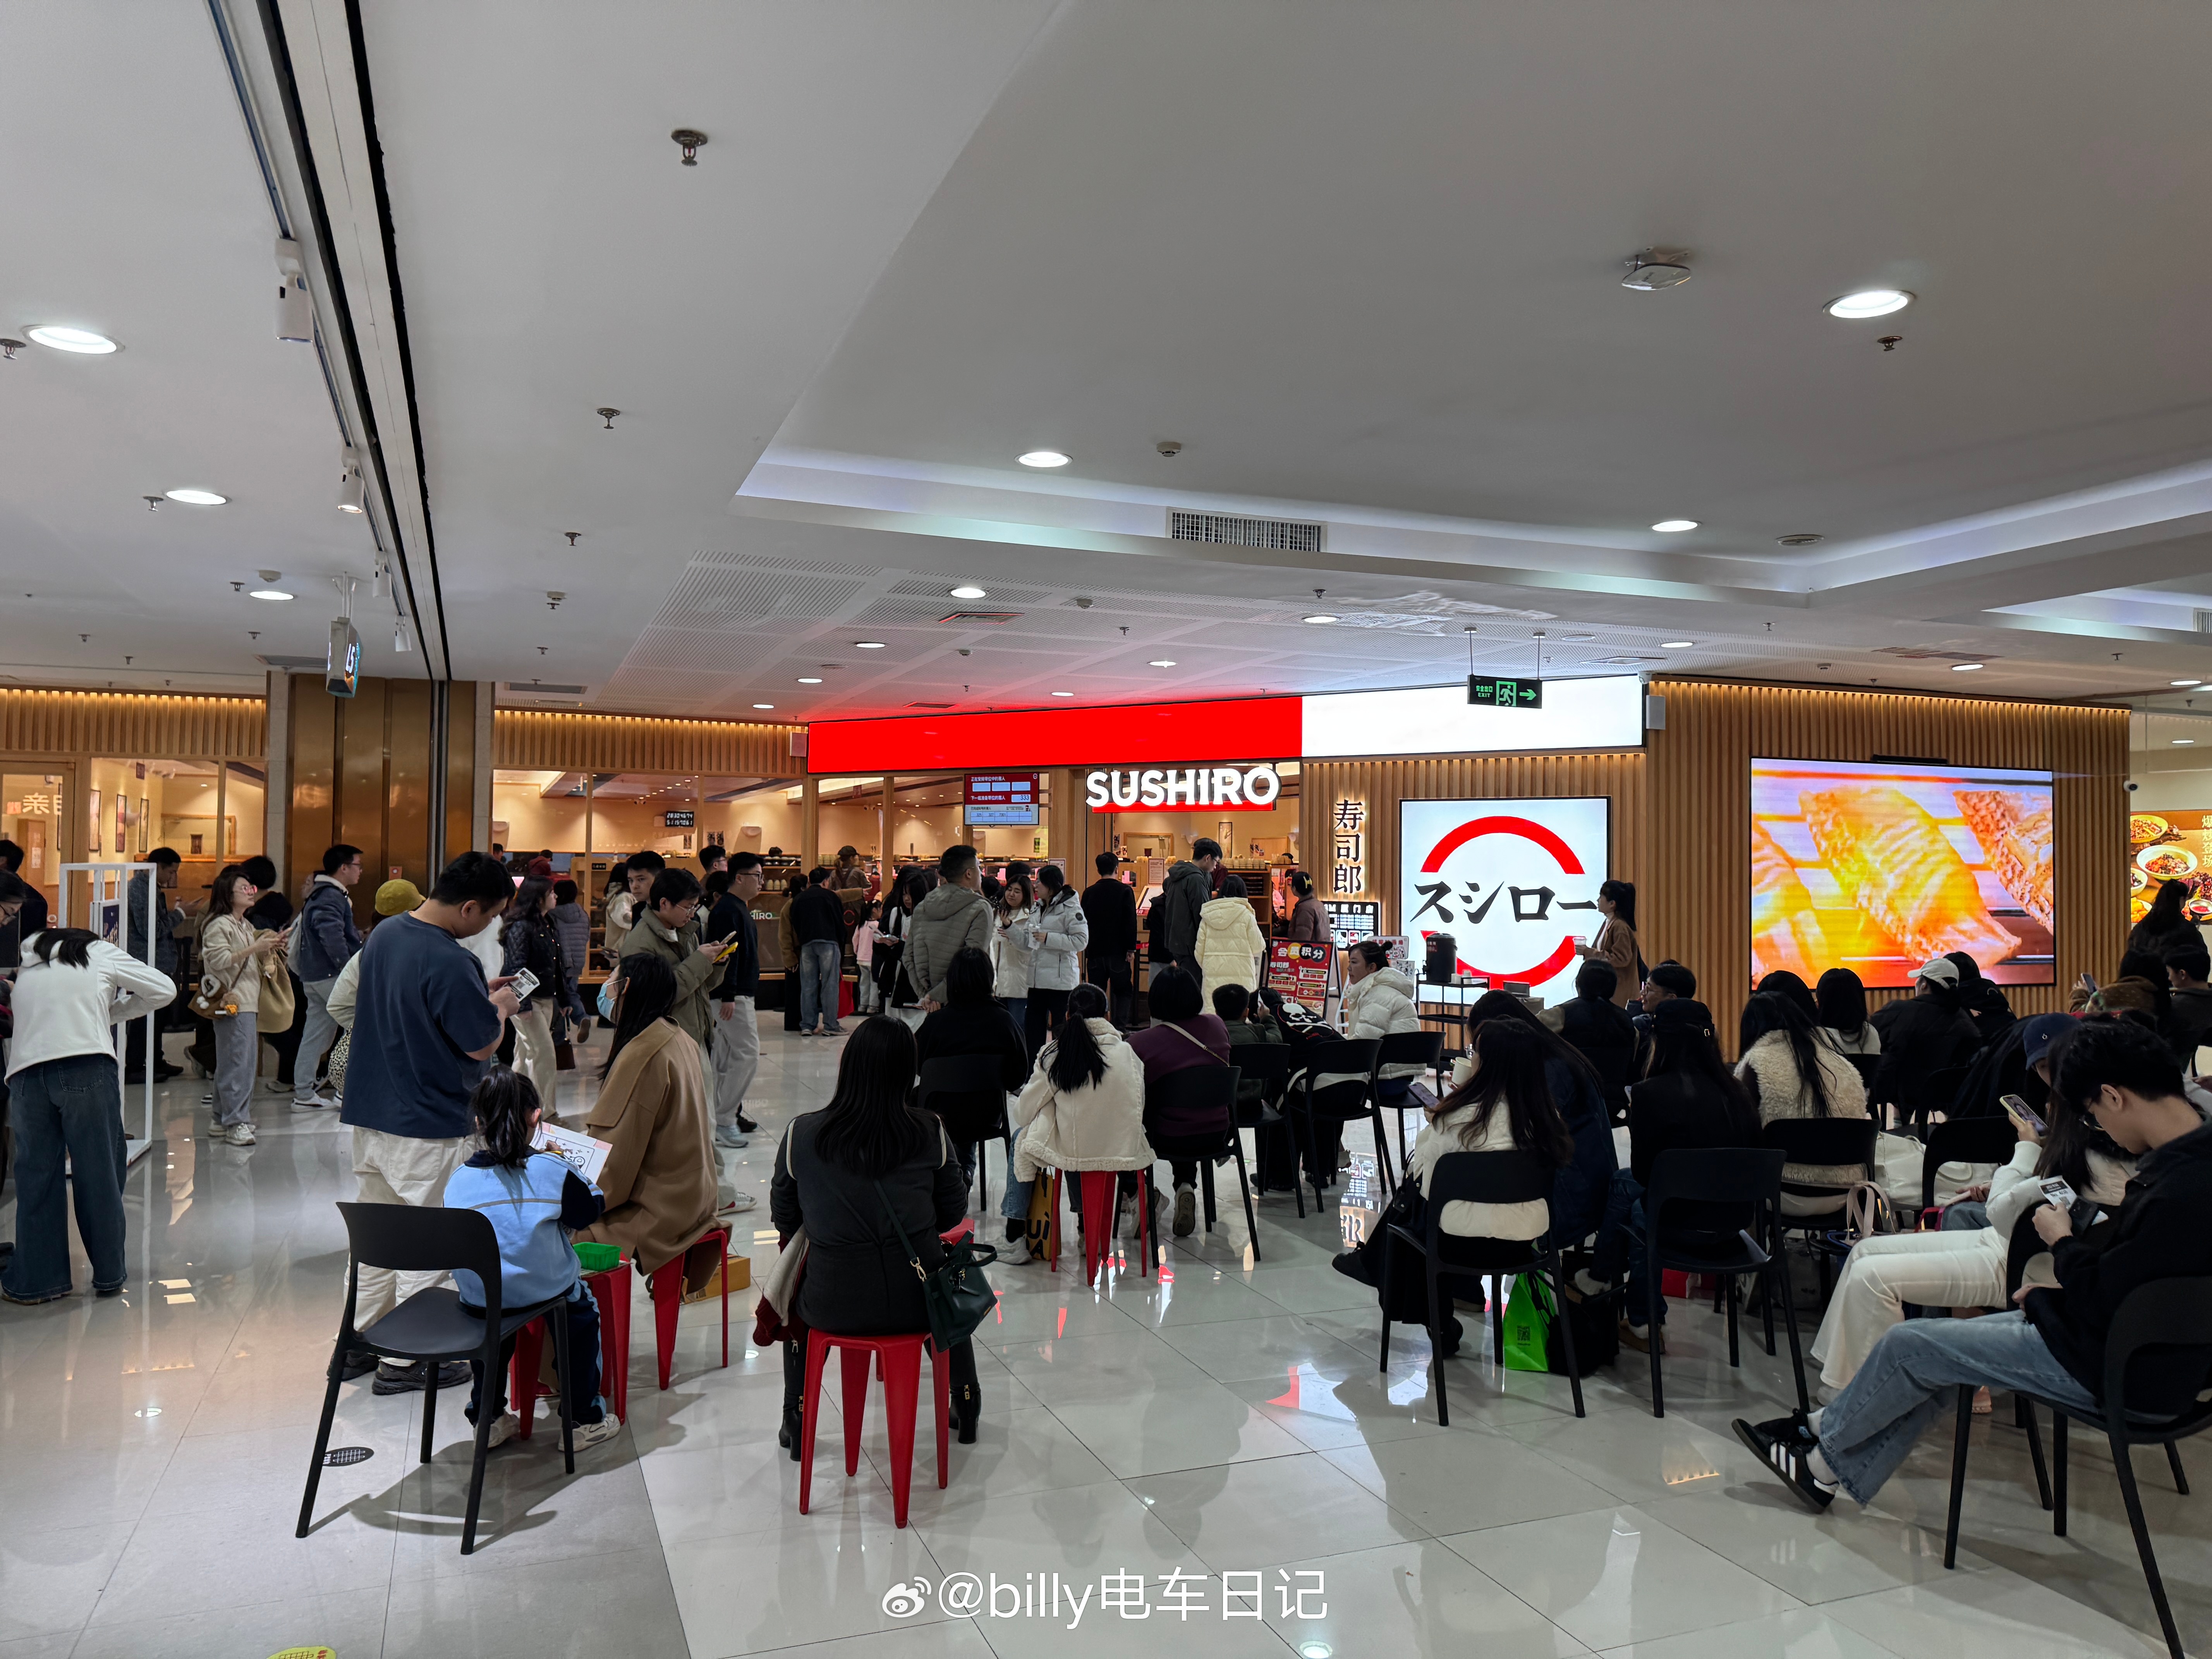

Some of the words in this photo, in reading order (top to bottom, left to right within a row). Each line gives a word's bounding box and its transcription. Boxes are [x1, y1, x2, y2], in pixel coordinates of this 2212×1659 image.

[1086, 767, 1279, 807] SUSHIRO
[1333, 799, 1364, 894] 寿司郎
[1410, 881, 1597, 924] スシロー
